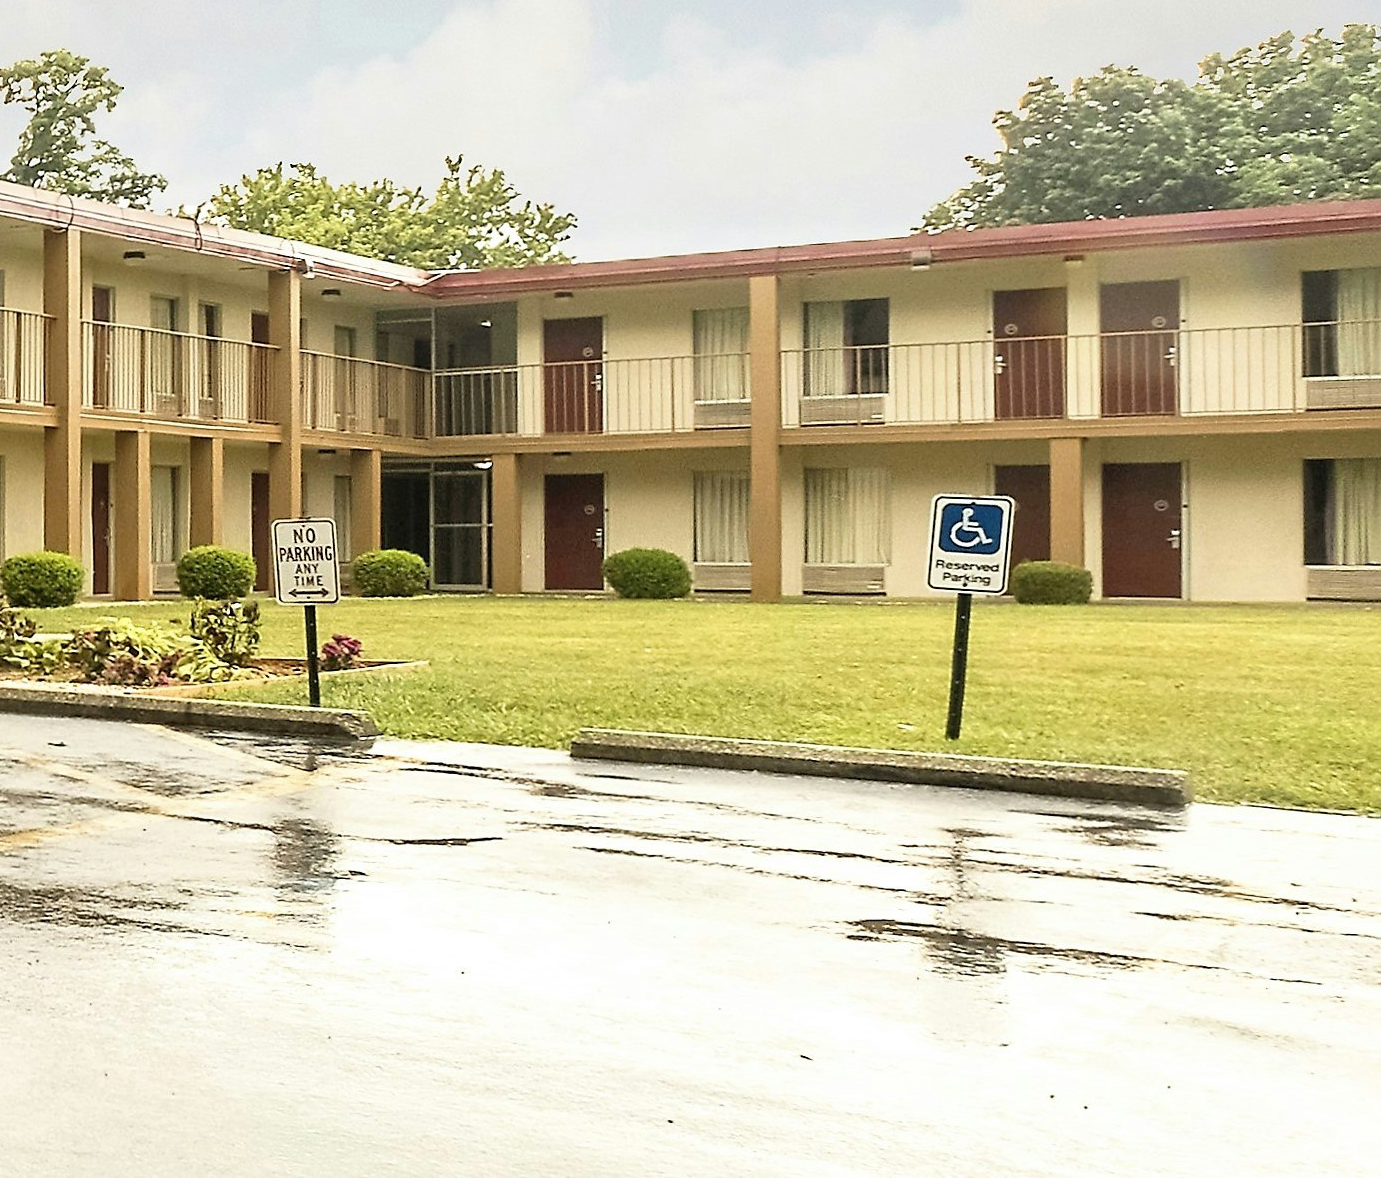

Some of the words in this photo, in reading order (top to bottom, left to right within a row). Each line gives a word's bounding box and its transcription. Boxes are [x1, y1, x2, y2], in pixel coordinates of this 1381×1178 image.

[293, 528, 316, 543] NO
[279, 546, 333, 562] PARKING
[295, 563, 319, 574] ANY
[935, 559, 999, 572] Reserved
[294, 575, 324, 586] TIME
[942, 572, 991, 586] Parking
